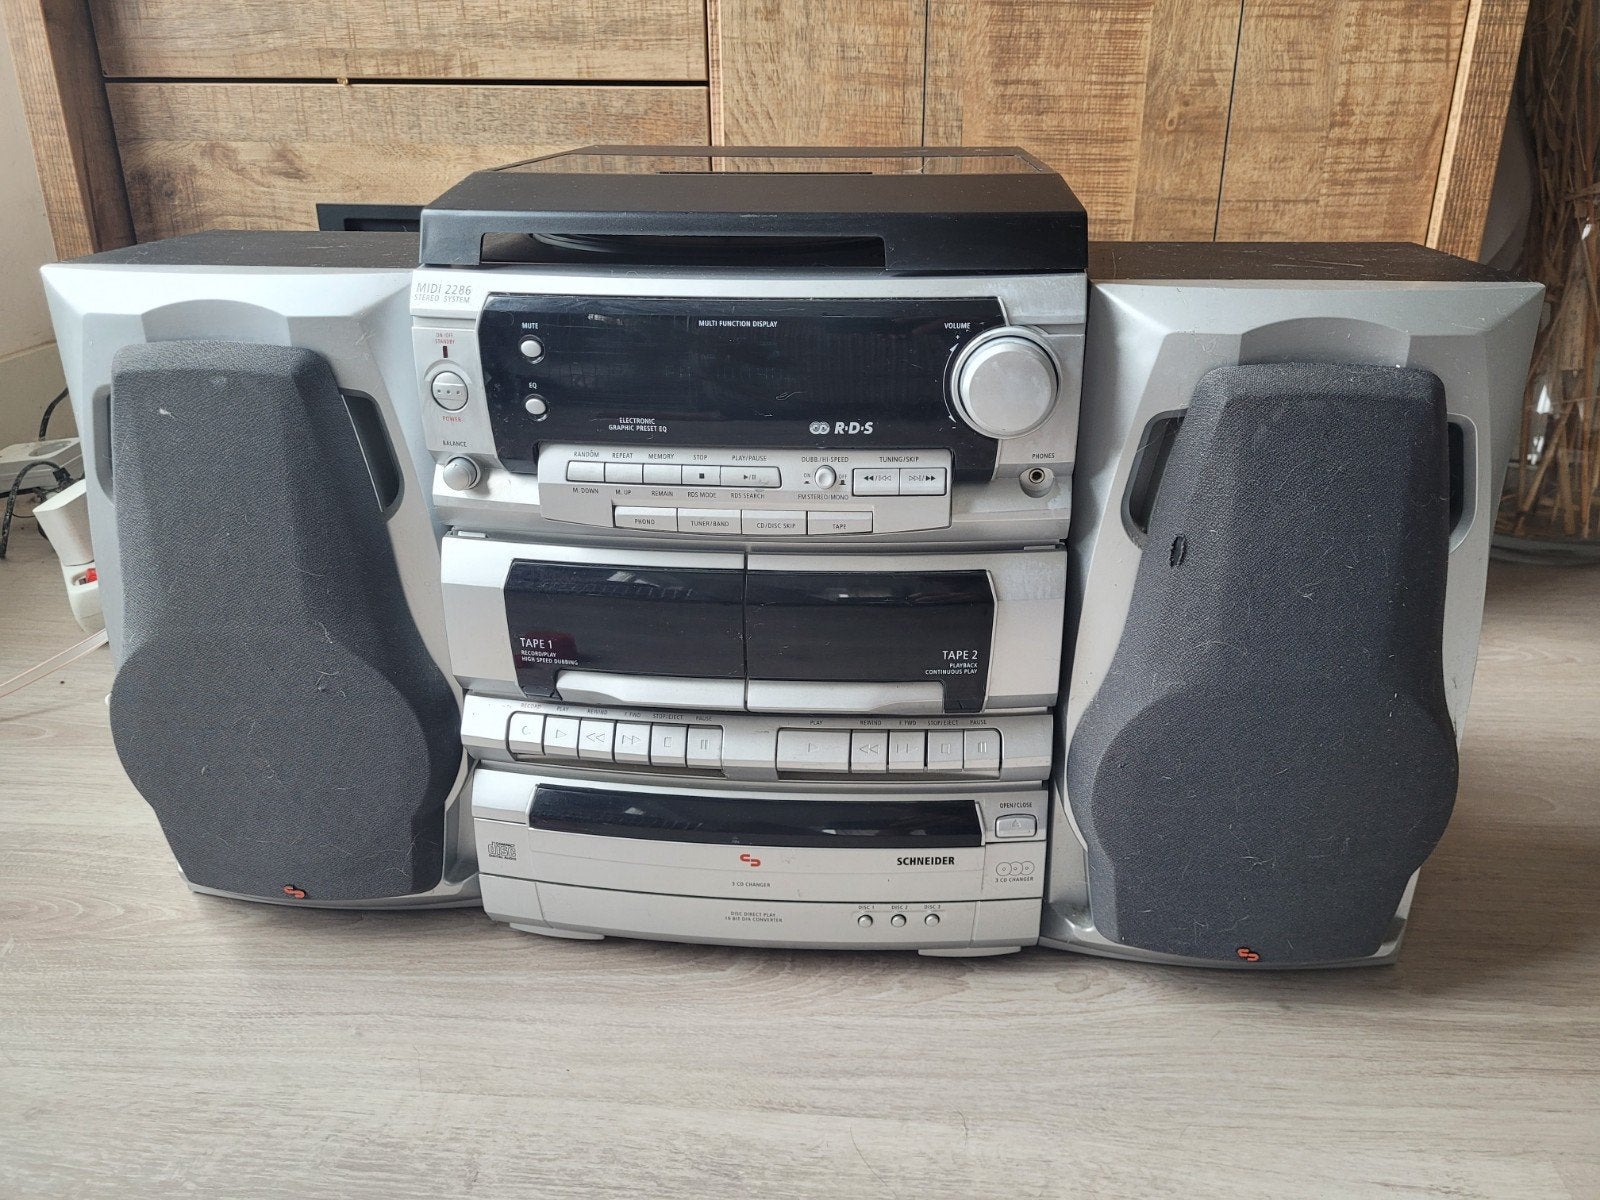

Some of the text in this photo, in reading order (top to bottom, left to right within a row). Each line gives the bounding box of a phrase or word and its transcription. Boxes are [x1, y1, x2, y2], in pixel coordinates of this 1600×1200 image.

[416, 283, 472, 295] MIDI 2286
[414, 294, 439, 302] STEREO
[522, 322, 539, 330] MUTE
[698, 320, 778, 328] MULTI FUNCTION DISPLAY
[944, 322, 971, 330] VOLUME
[529, 382, 538, 390] EQ
[619, 417, 656, 425] ELECTRONIC
[608, 424, 635, 432] GRAPHIC
[442, 440, 467, 448] BALANCE
[520, 637, 553, 649] TAPE 1
[521, 650, 557, 658] RECORD/PLAY
[942, 650, 978, 660] TAPE 2
[897, 857, 955, 866] SCHNEIDER
